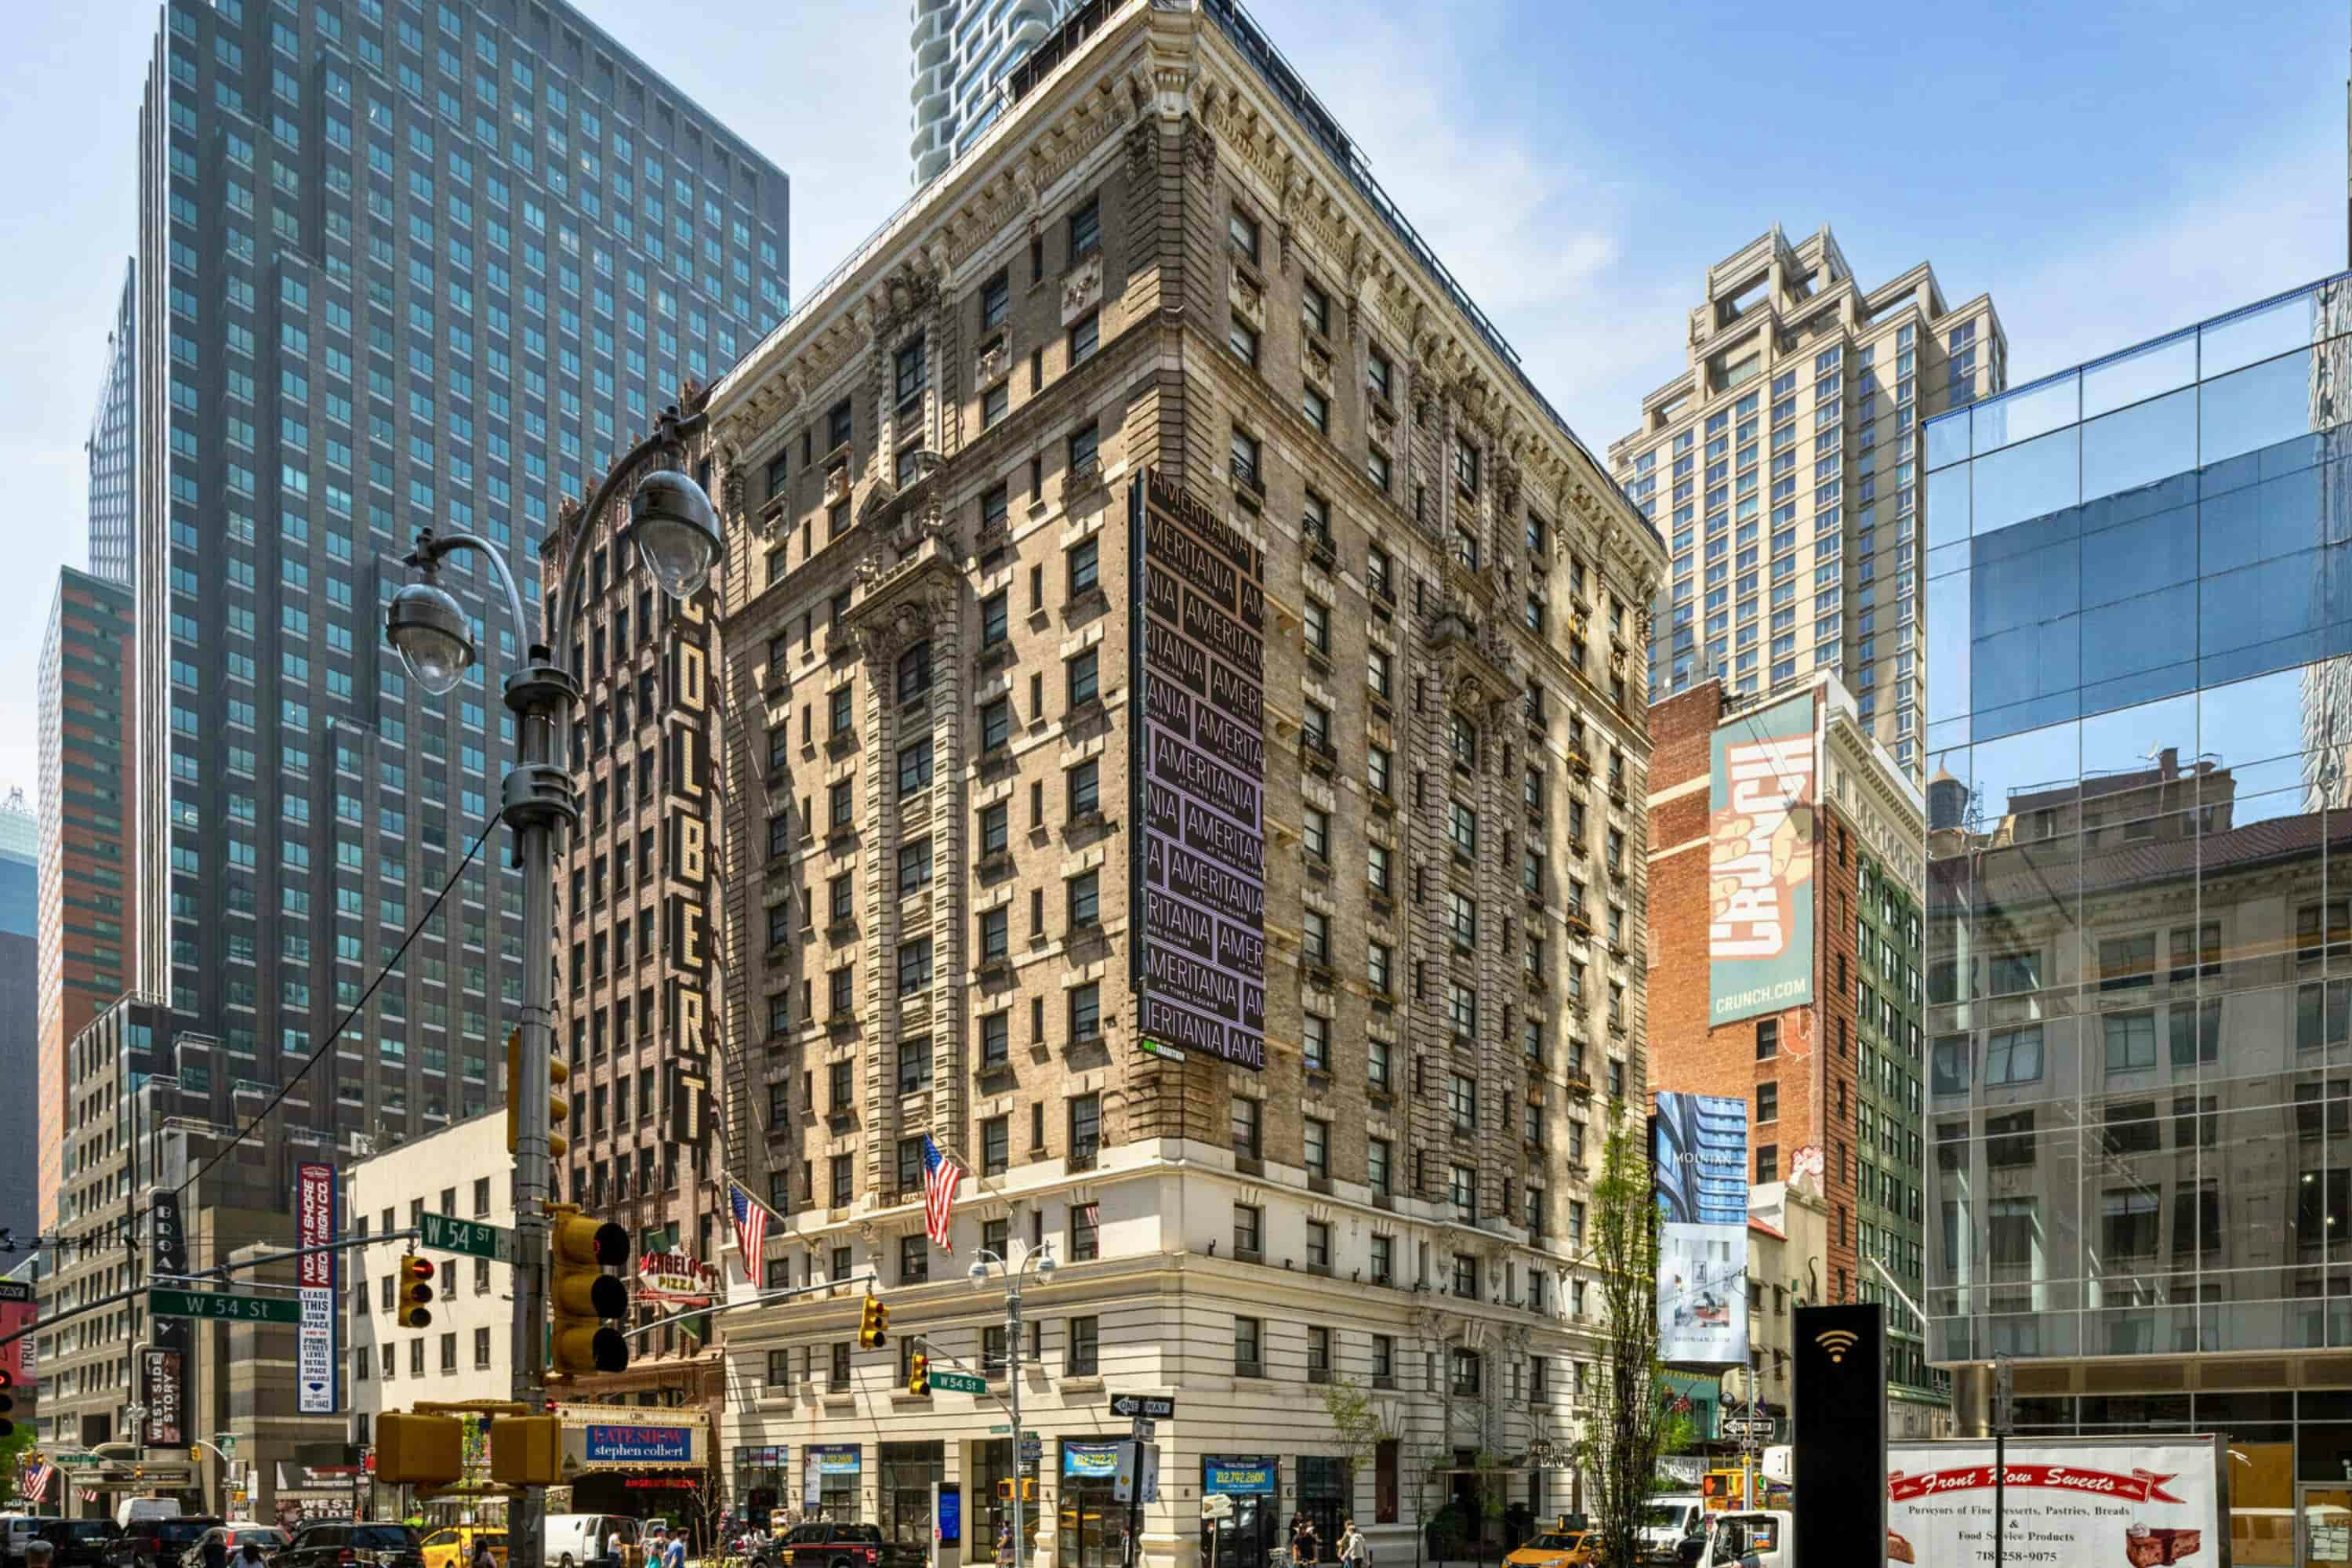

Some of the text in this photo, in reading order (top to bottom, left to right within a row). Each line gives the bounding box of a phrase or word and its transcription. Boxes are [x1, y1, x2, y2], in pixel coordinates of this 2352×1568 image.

[1158, 738, 1254, 814] AMERITANIA
[1149, 784, 1177, 824] NIA
[1710, 737, 1813, 957] CRUNCH
[1149, 840, 1265, 916] A AMERITANIA
[1149, 892, 1264, 967] RITANIA AMER
[1171, 986, 1190, 1000] TIMES
[1192, 996, 1218, 1010] SQUARE
[1716, 978, 1806, 1014] CRUNCH.COM
[303, 1179, 314, 1229] SHORE
[317, 1205, 328, 1240] SIGN
[426, 1216, 441, 1245] W
[448, 1221, 470, 1250] 54
[476, 1227, 491, 1242] ST
[659, 1276, 697, 1293] PIZZA
[303, 1291, 328, 1300] LEASE
[186, 1296, 270, 1318] W 54 St
[305, 1300, 328, 1311] THIS
[303, 1320, 329, 1329] SPACE
[941, 1376, 976, 1390] W 54 St
[152, 1353, 163, 1440] WEST SIDE
[163, 1374, 174, 1423] STORY
[1120, 1400, 1167, 1411] ONE WAY
[594, 1428, 681, 1443] LATE SHOW
[595, 1443, 683, 1460] stephen colbert
[1921, 1472, 1976, 1495] Front
[2045, 1468, 2114, 1490] Sweets
[301, 1499, 353, 1509] WEST
[1908, 1505, 2130, 1517] Purveyors of Fine esserts, Pastries, Breads
[303, 1509, 353, 1519] SIDE
[2009, 1519, 2019, 1529] &
[1958, 1531, 2074, 1541] Food Sevice Products
[1976, 1551, 2056, 1562] 718258-9075
